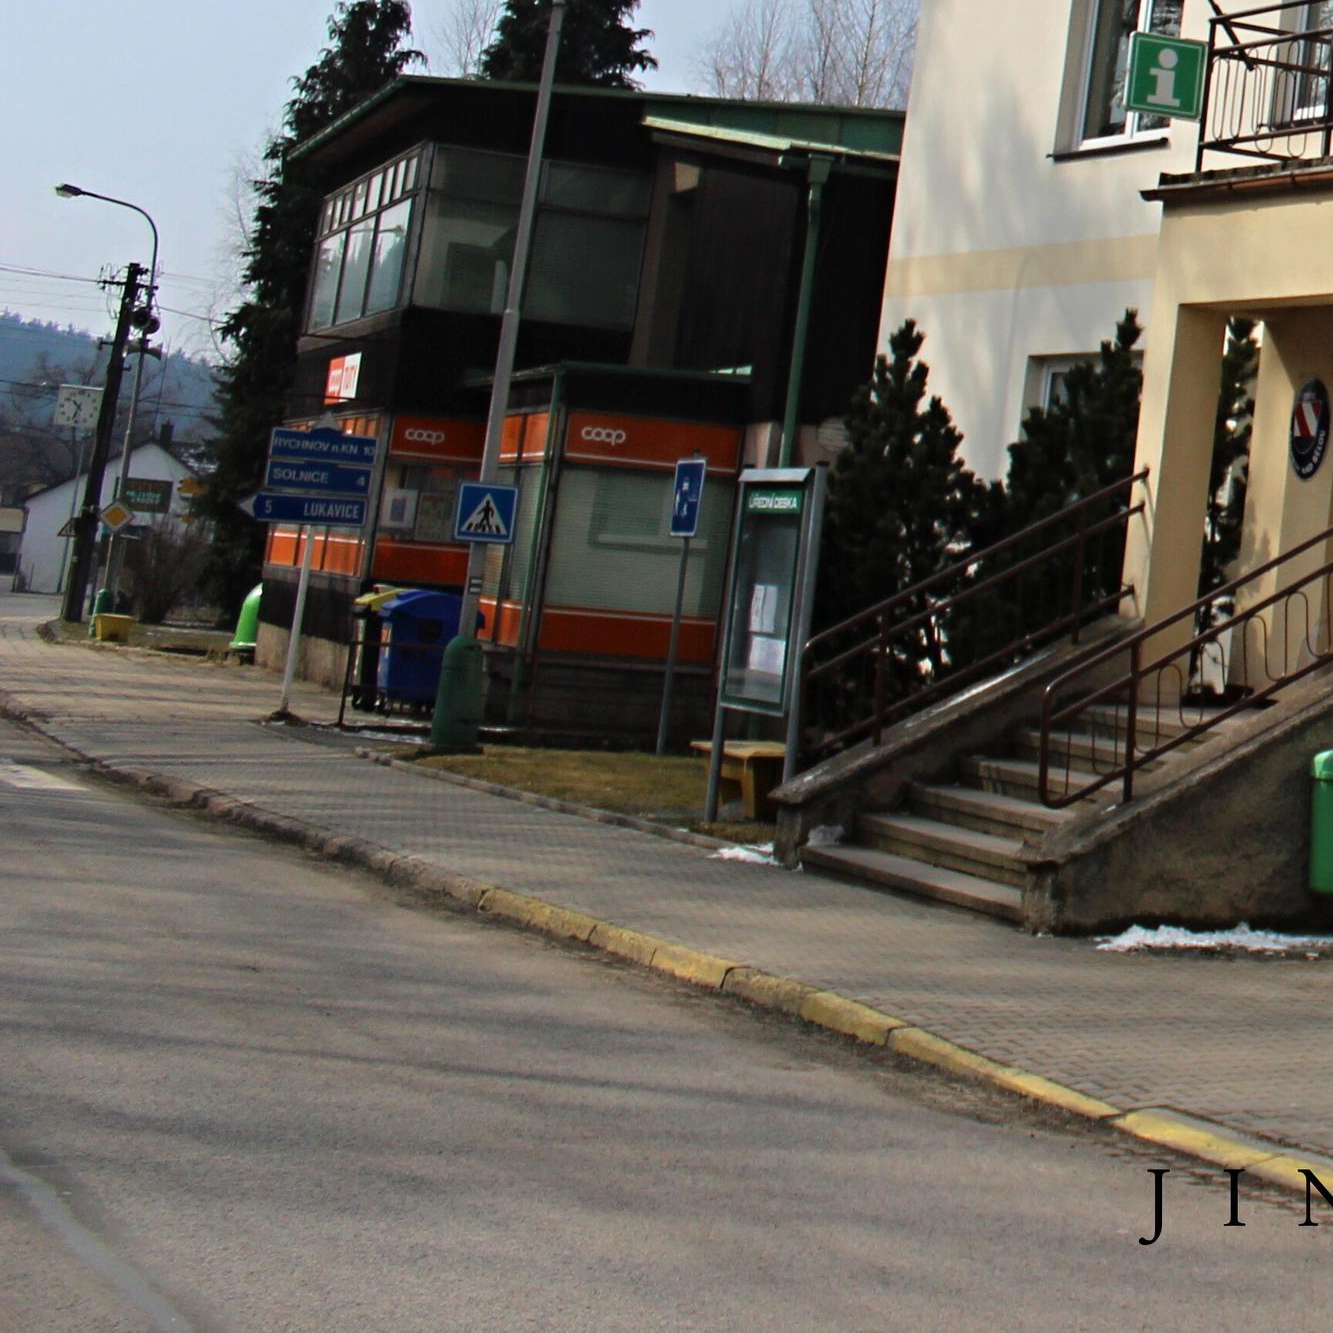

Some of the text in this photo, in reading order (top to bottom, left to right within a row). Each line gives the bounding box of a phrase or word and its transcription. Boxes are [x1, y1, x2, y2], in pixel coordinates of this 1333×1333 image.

[405, 428, 445, 446] coop
[581, 427, 626, 446] coop
[273, 468, 366, 487] SOLNICE 4
[264, 499, 360, 519] 5 LUKAVICE
